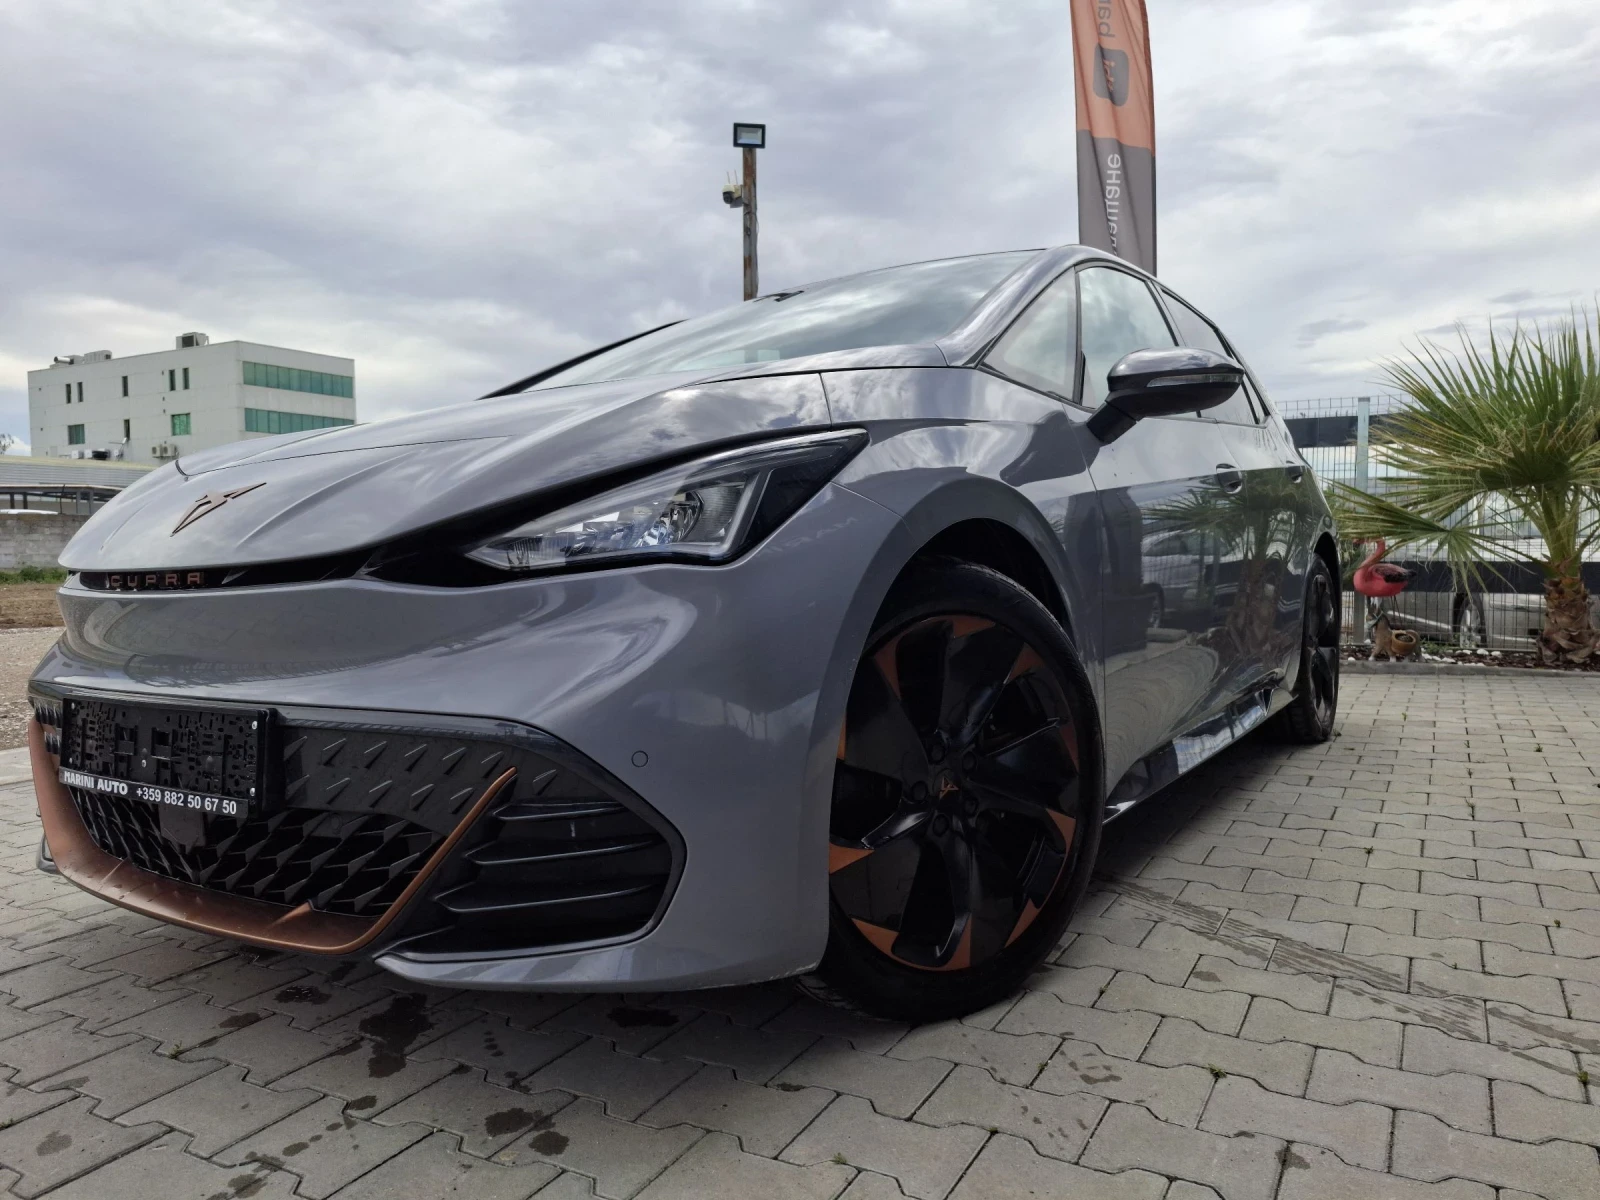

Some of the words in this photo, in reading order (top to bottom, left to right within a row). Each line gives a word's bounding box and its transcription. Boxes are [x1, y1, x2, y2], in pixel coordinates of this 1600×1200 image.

[110, 572, 200, 588] CUPRA
[64, 770, 95, 789] MARINI
[97, 778, 128, 795] AUTO
[136, 787, 162, 802] +359
[164, 791, 185, 807] 882
[187, 794, 202, 809] 50
[204, 797, 219, 812] 67
[222, 800, 237, 815] 50
